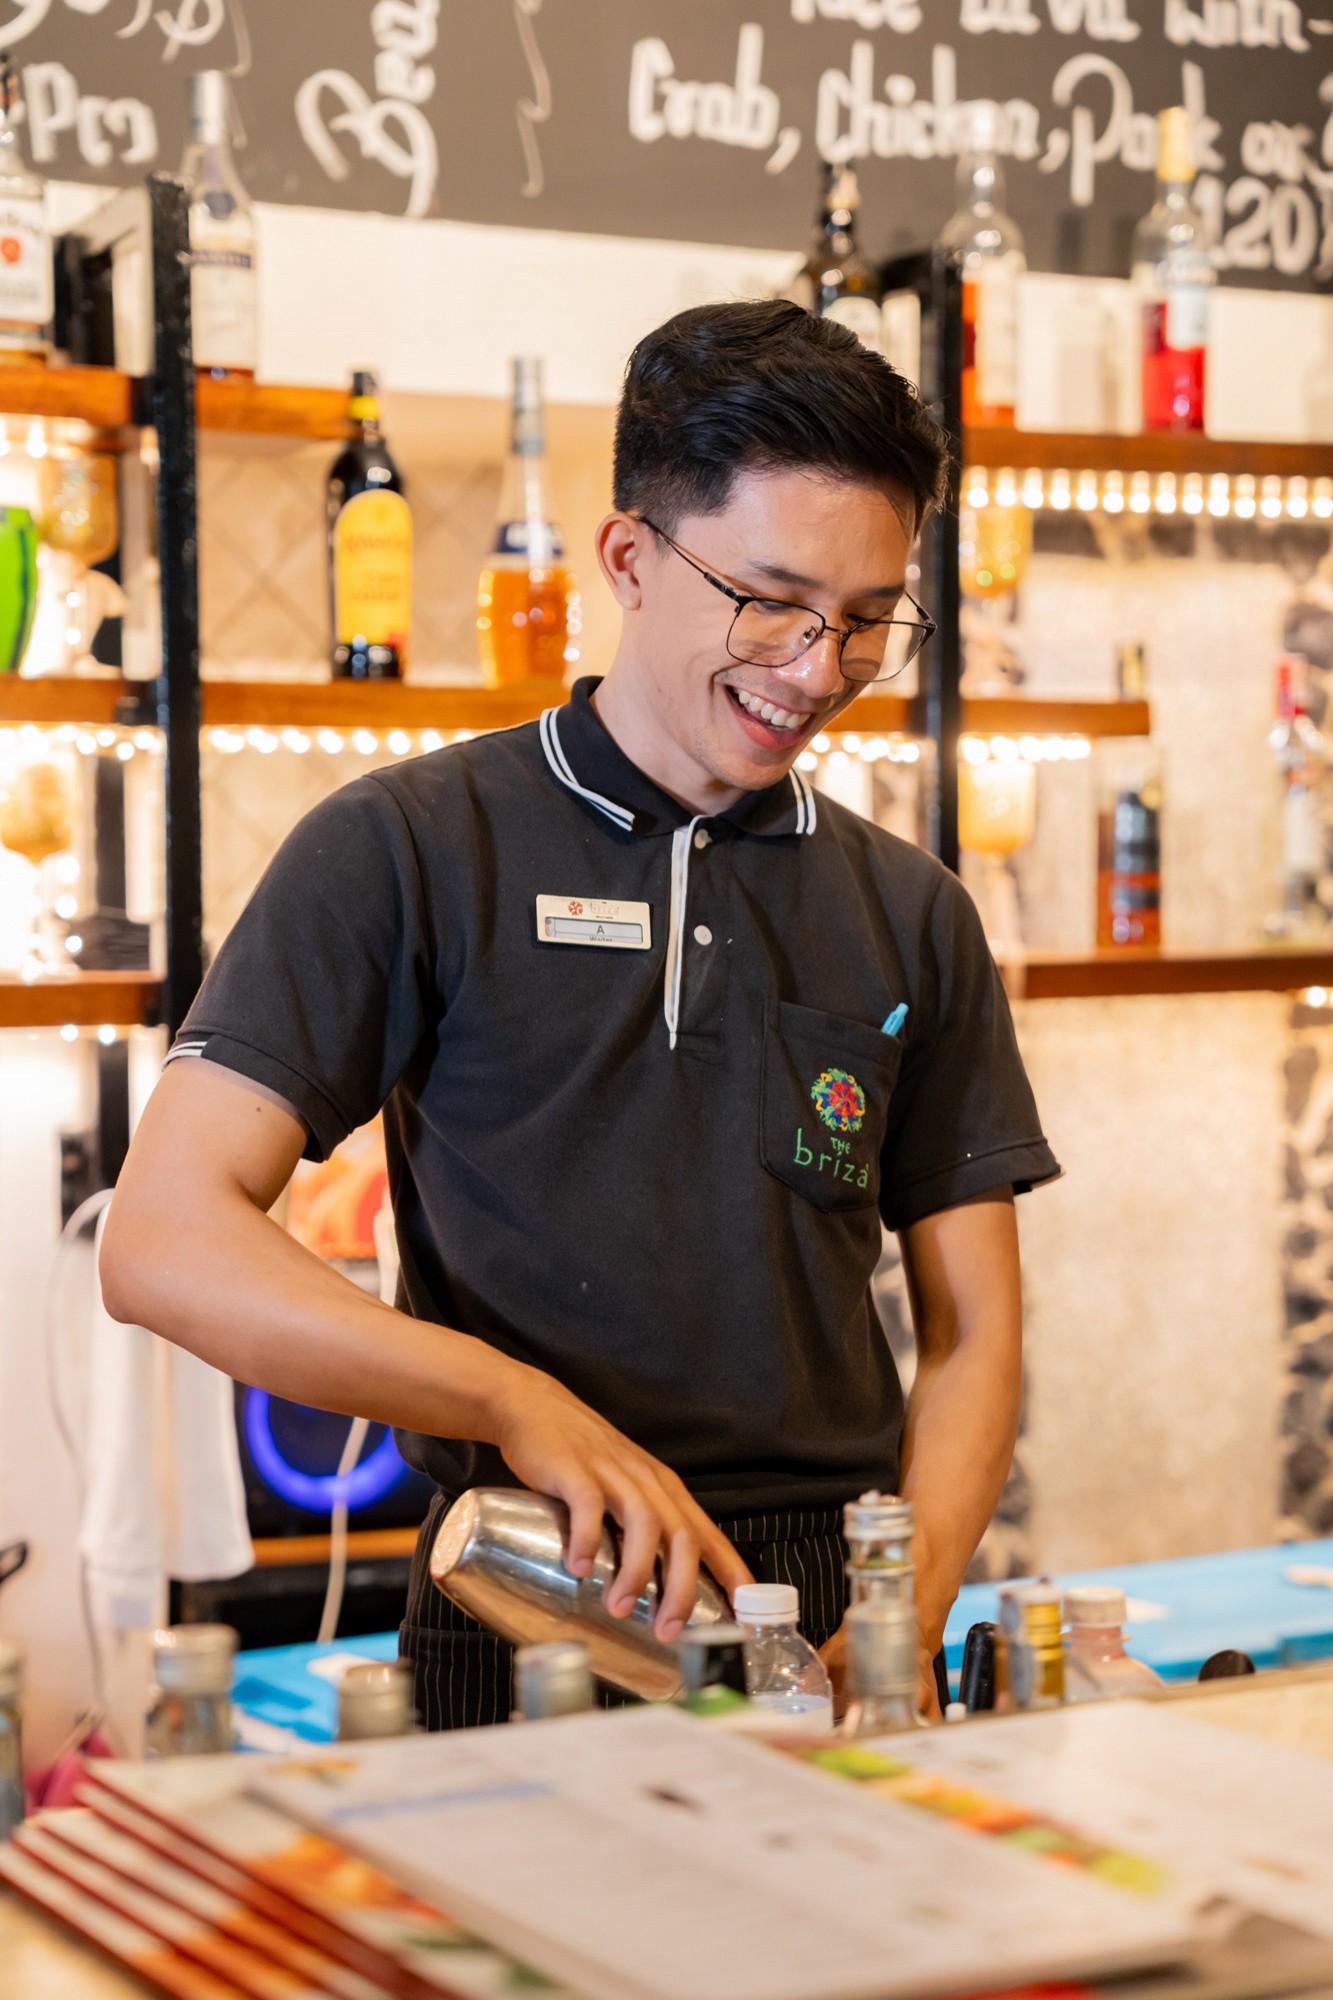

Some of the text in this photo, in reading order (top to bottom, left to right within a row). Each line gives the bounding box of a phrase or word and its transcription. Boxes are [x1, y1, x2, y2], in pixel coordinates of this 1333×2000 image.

[628, 21, 801, 175] Crab,
[1051, 52, 1226, 207] Pok
[596, 924, 605, 935] A
[830, 1136, 851, 1154] THE
